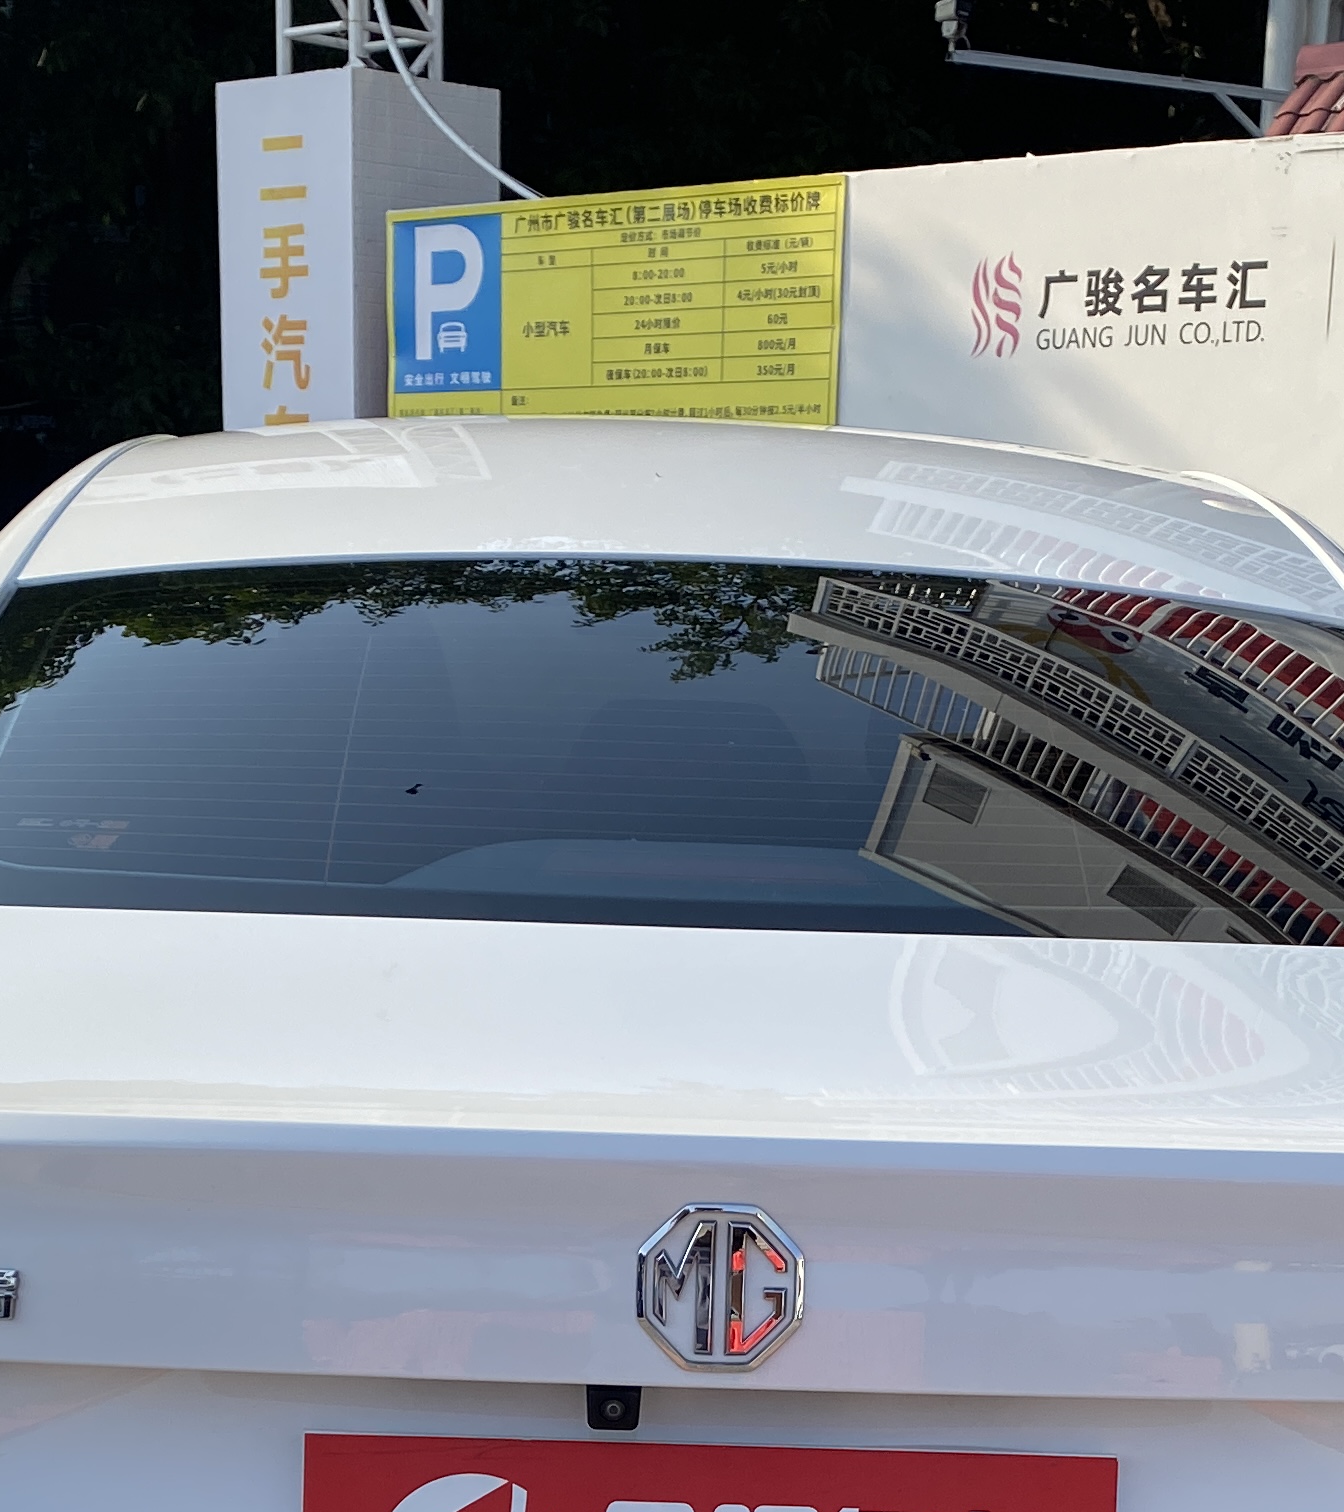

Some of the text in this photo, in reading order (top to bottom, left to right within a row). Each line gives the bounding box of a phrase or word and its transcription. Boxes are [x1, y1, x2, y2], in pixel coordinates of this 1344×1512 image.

[414, 223, 485, 361] P
[1037, 260, 1269, 319] 广骏名车汇
[522, 319, 571, 338] 小型汽车
[1036, 325, 1114, 351] GUANG
[1123, 322, 1168, 347] JUN
[653, 1219, 788, 1356] MG
